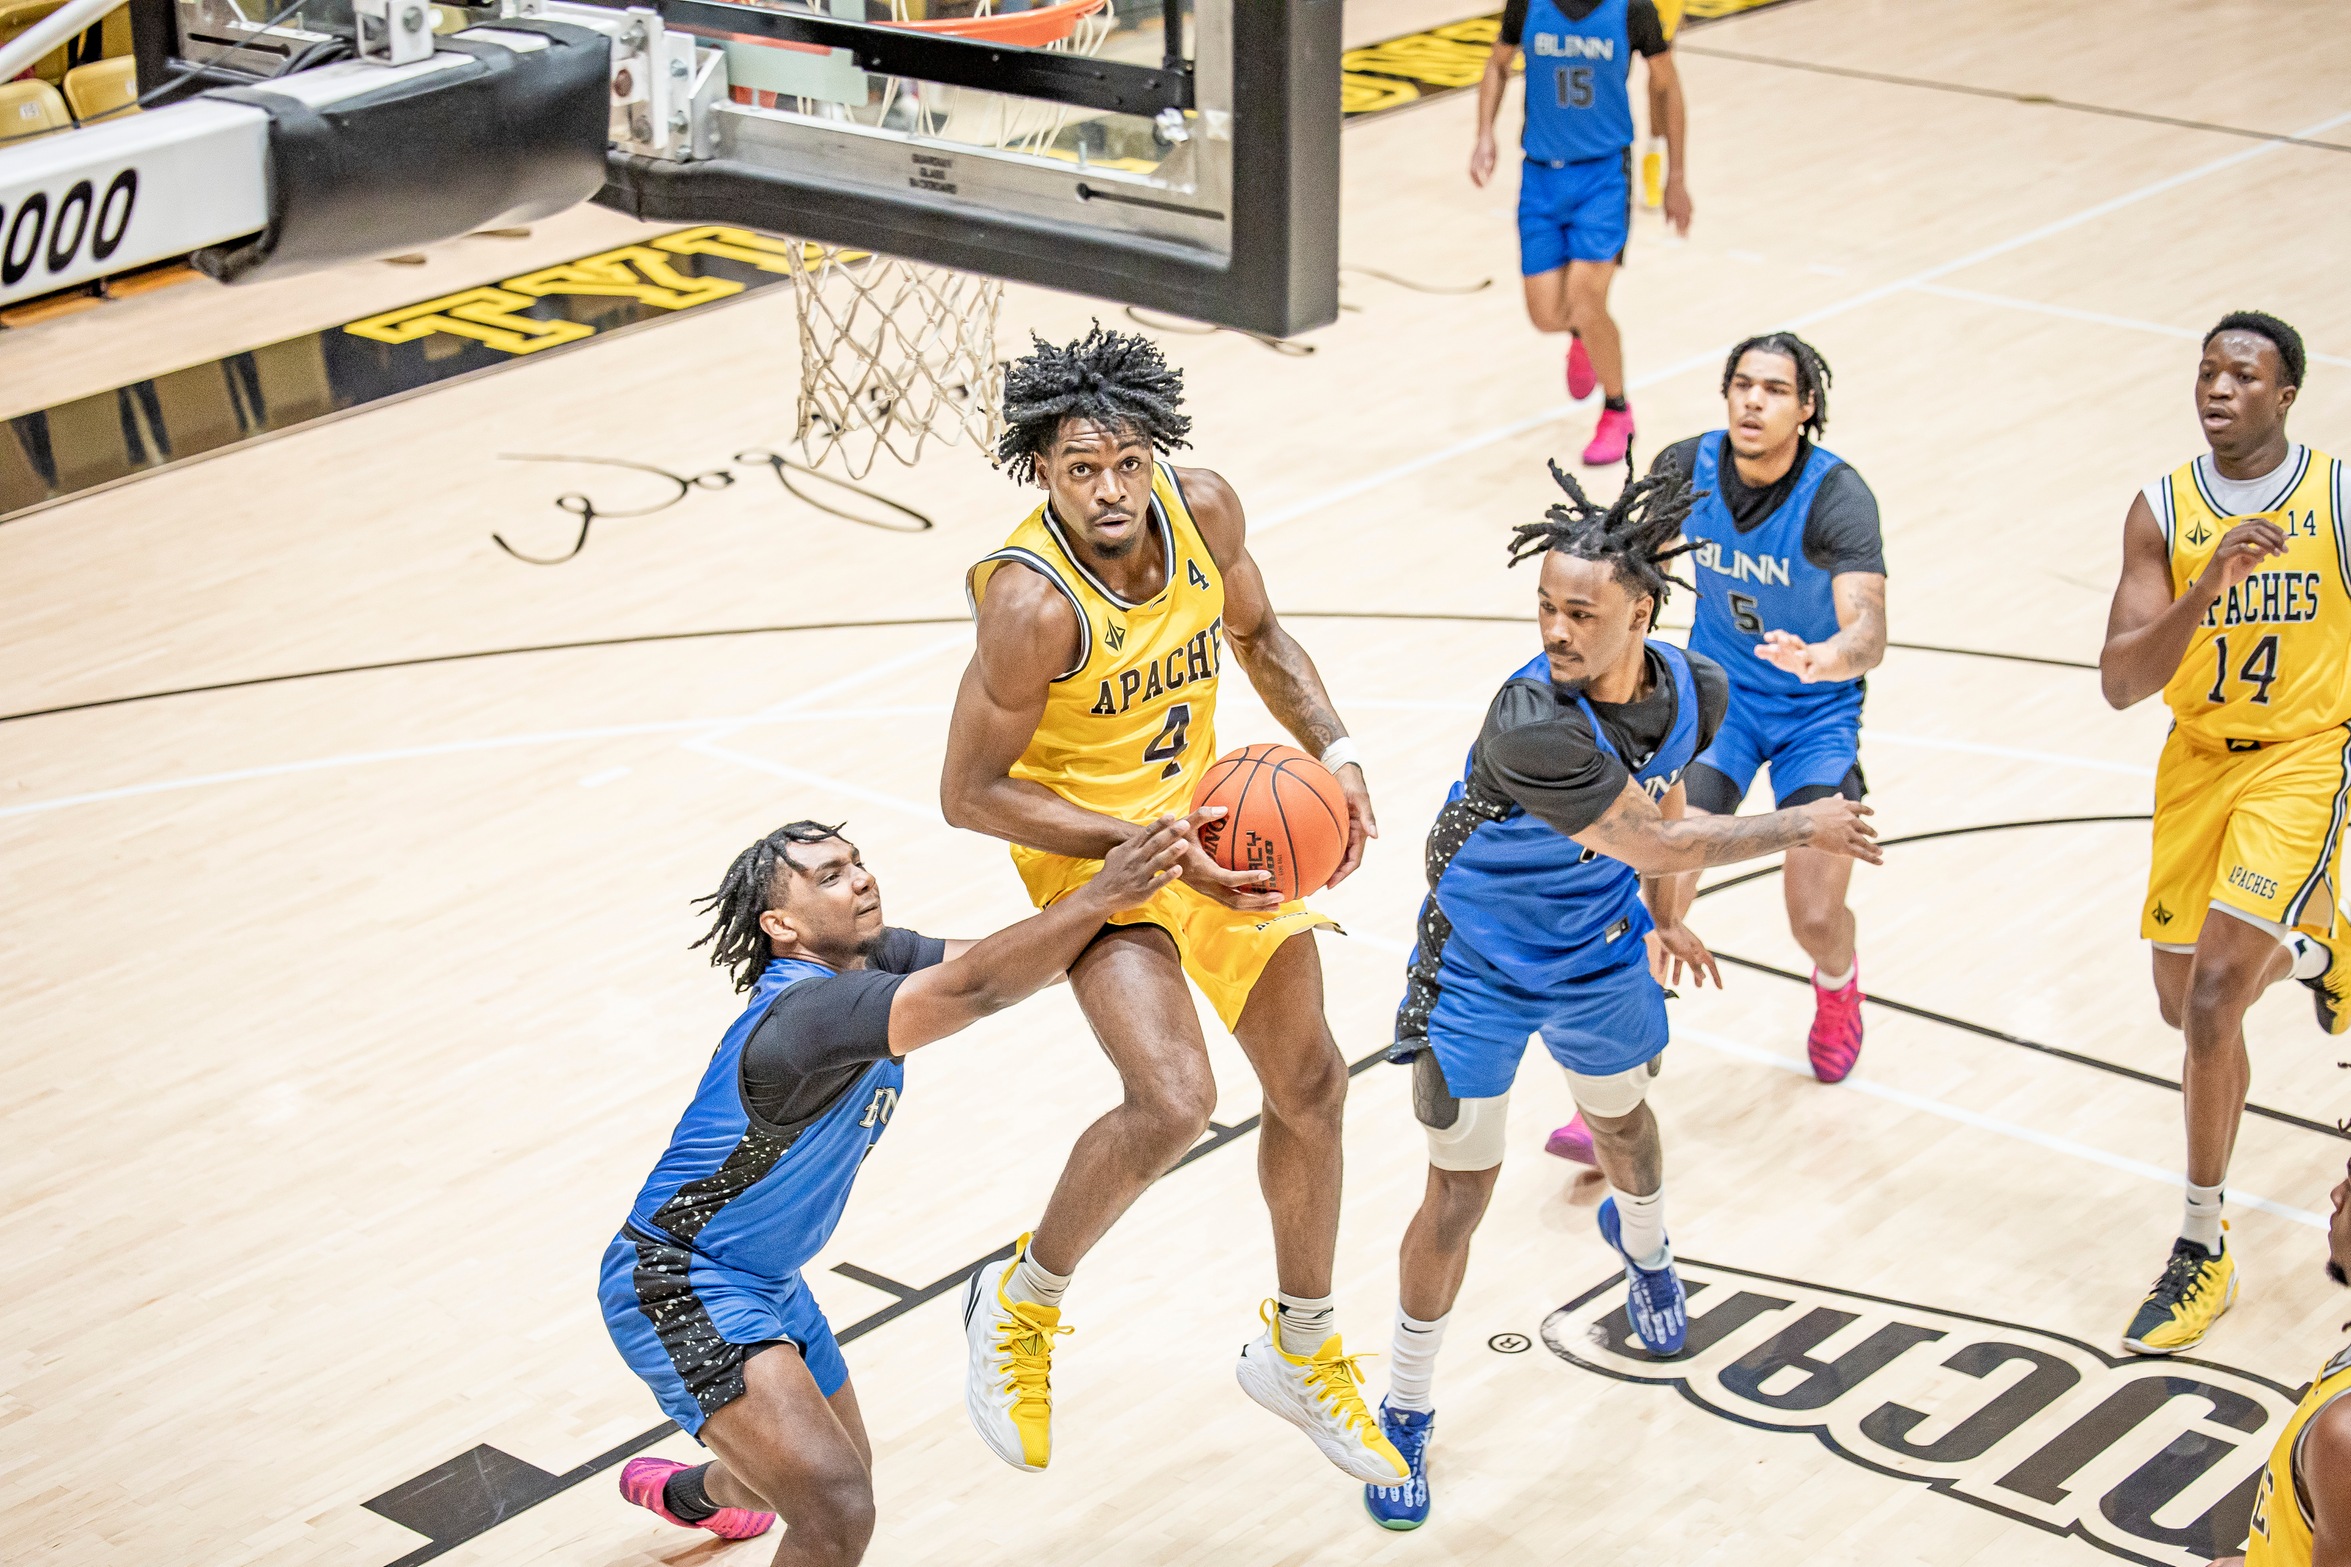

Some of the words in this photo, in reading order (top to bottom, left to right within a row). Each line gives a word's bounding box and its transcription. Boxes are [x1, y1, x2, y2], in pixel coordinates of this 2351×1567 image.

[1534, 32, 1614, 61] BLINN
[1554, 66, 1596, 109] 15
[0, 167, 138, 287] 000
[344, 225, 872, 354] TYL
[2288, 510, 2317, 537] 14
[1186, 557, 1210, 592] 4
[1694, 536, 1791, 587] BLINN
[1727, 589, 1765, 635] 5
[2189, 572, 2322, 628] ACHES
[1090, 615, 1222, 716] APACHE
[2208, 634, 2281, 705] 14
[1142, 702, 1191, 782] 4
[2228, 865, 2279, 900] APACHES
